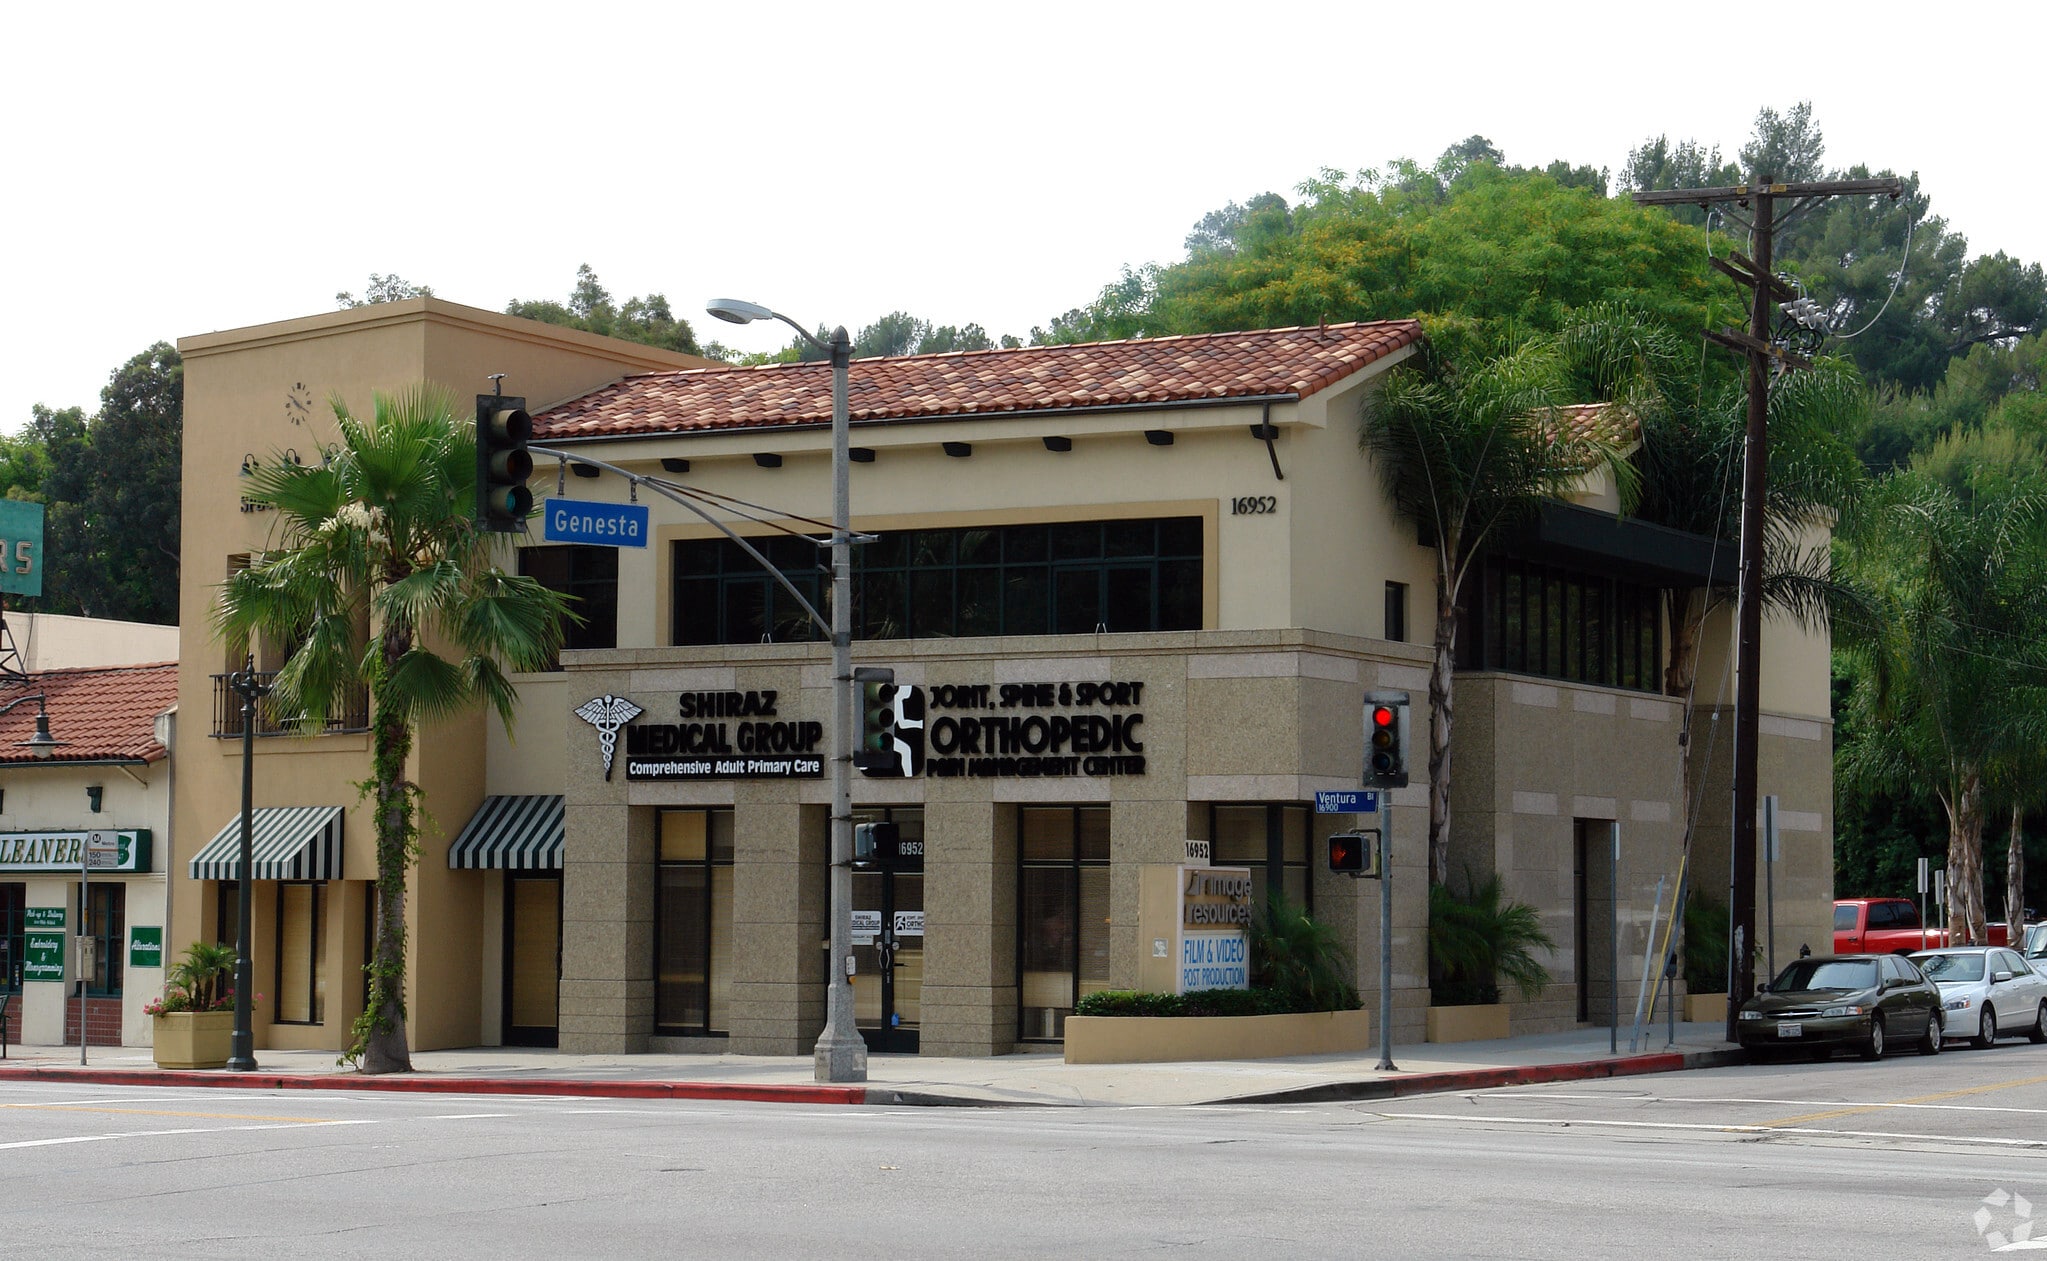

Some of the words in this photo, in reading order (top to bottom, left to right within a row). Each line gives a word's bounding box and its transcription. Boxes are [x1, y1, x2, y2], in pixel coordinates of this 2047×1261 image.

[1231, 495, 1277, 515] 16952
[555, 510, 639, 537] Genesta
[679, 690, 777, 718] SHIRAZ
[929, 684, 996, 710] JOINT,
[999, 683, 1055, 707] SPINE
[1058, 682, 1073, 706] &
[1076, 681, 1144, 706] SPORT
[626, 723, 732, 755] MEDICAL
[737, 721, 823, 753] GROUP
[930, 713, 1144, 755] ORTHOPEDIC
[629, 760, 711, 776] Comprehensive
[715, 759, 745, 774] Adult
[747, 759, 791, 776] Primary
[794, 759, 820, 773] Care
[926, 757, 965, 777] PAIN
[967, 756, 1081, 777] MANAGEMENT
[1082, 755, 1146, 776] CENTER
[1319, 792, 1357, 804] Ventura
[1319, 803, 1339, 812] 16900
[1185, 841, 1209, 859] 16952
[1188, 903, 1252, 924] resources
[1184, 939, 1205, 964] FILM
[1207, 939, 1214, 963] &
[1216, 938, 1244, 963] VIDEO
[1183, 968, 1201, 987] POST
[1202, 967, 1245, 986] PRODUCTION
